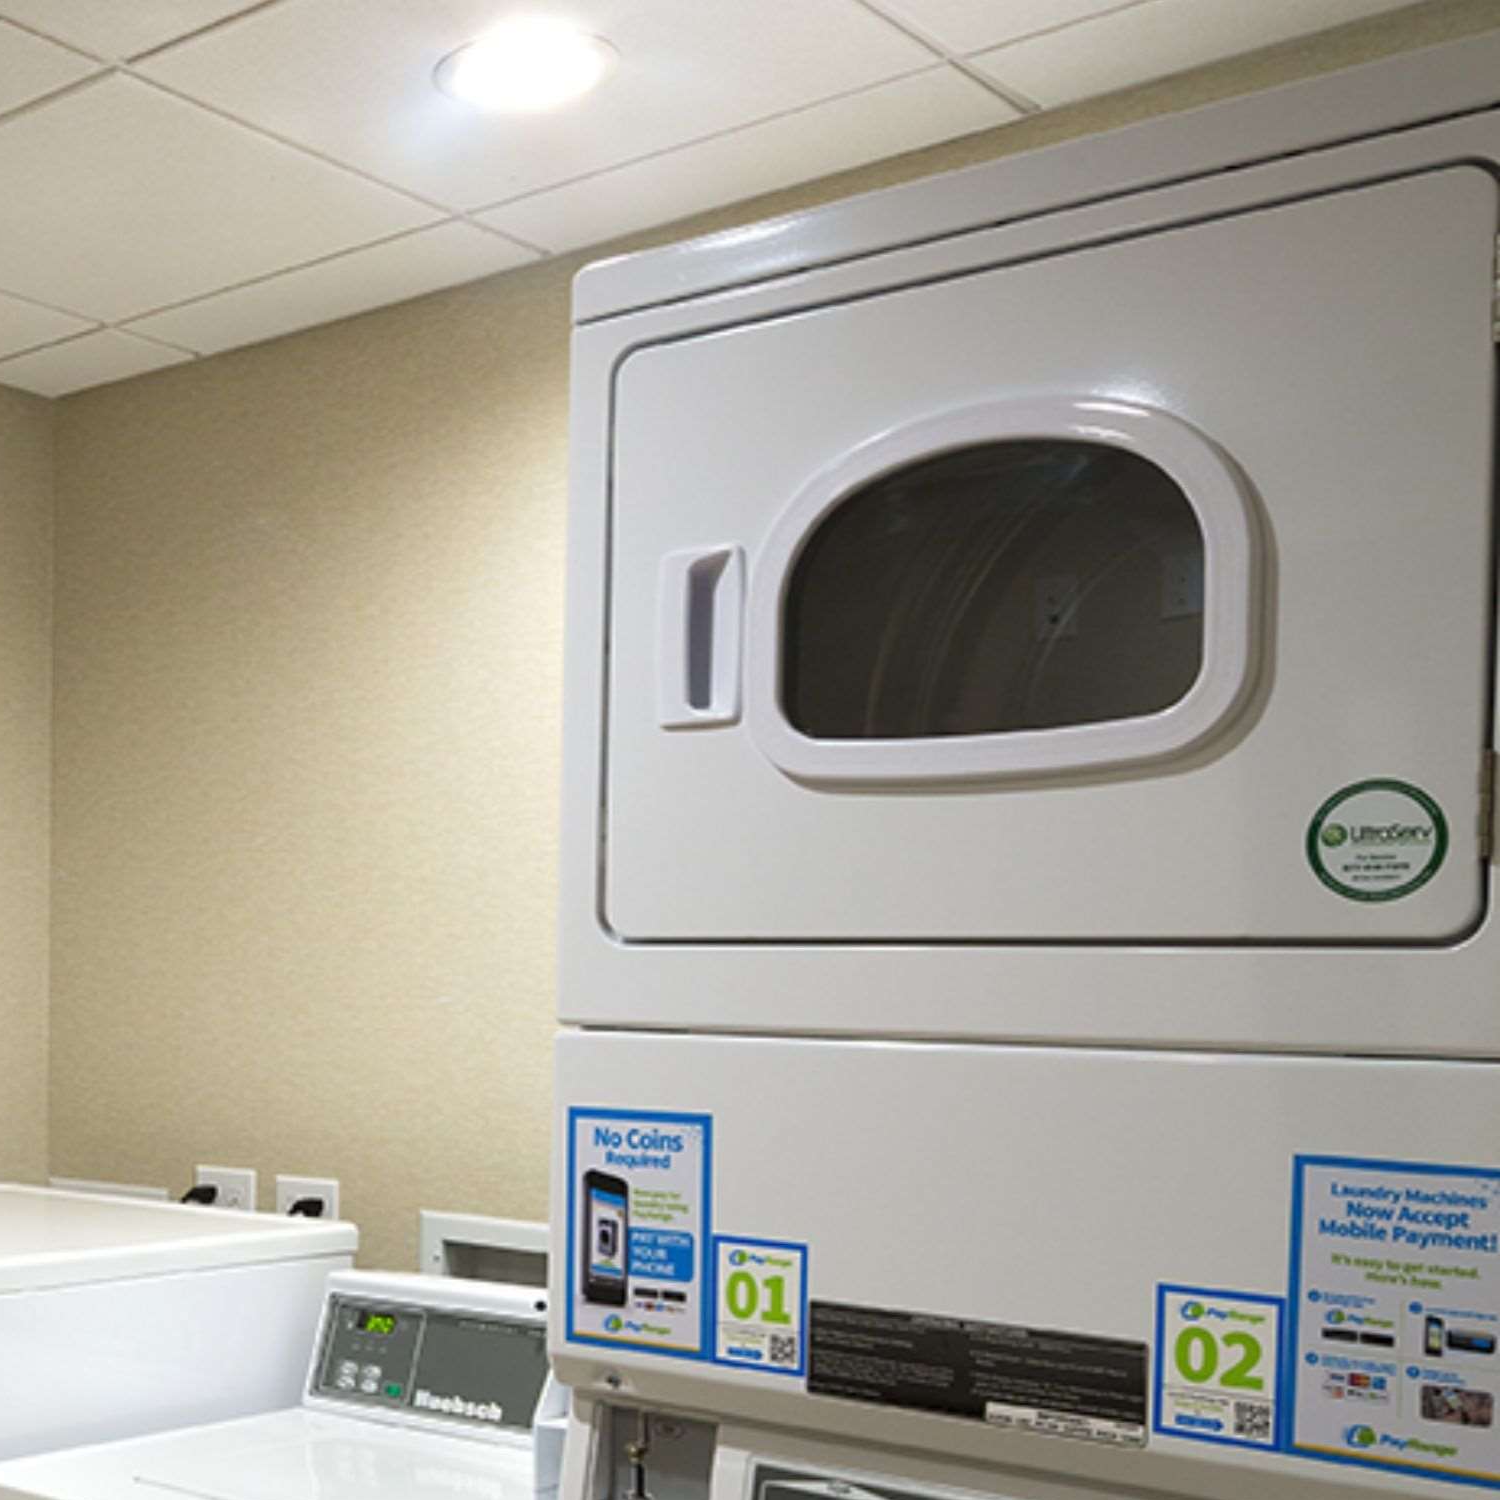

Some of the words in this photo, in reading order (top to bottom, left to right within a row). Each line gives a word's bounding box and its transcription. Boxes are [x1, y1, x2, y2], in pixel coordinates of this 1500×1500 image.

[595, 1126, 622, 1147] No
[626, 1128, 684, 1152] Coins
[605, 1151, 671, 1170] Required
[1331, 1182, 1400, 1204] Laundry
[1405, 1188, 1488, 1210] Machines
[1346, 1203, 1394, 1221] Now
[1398, 1207, 1469, 1230] Accept
[1318, 1219, 1387, 1242] Mobile
[1392, 1225, 1498, 1252] Payment!
[726, 1271, 791, 1324] 01
[1174, 1326, 1264, 1391] 02
[414, 1390, 503, 1421] Huebsch
